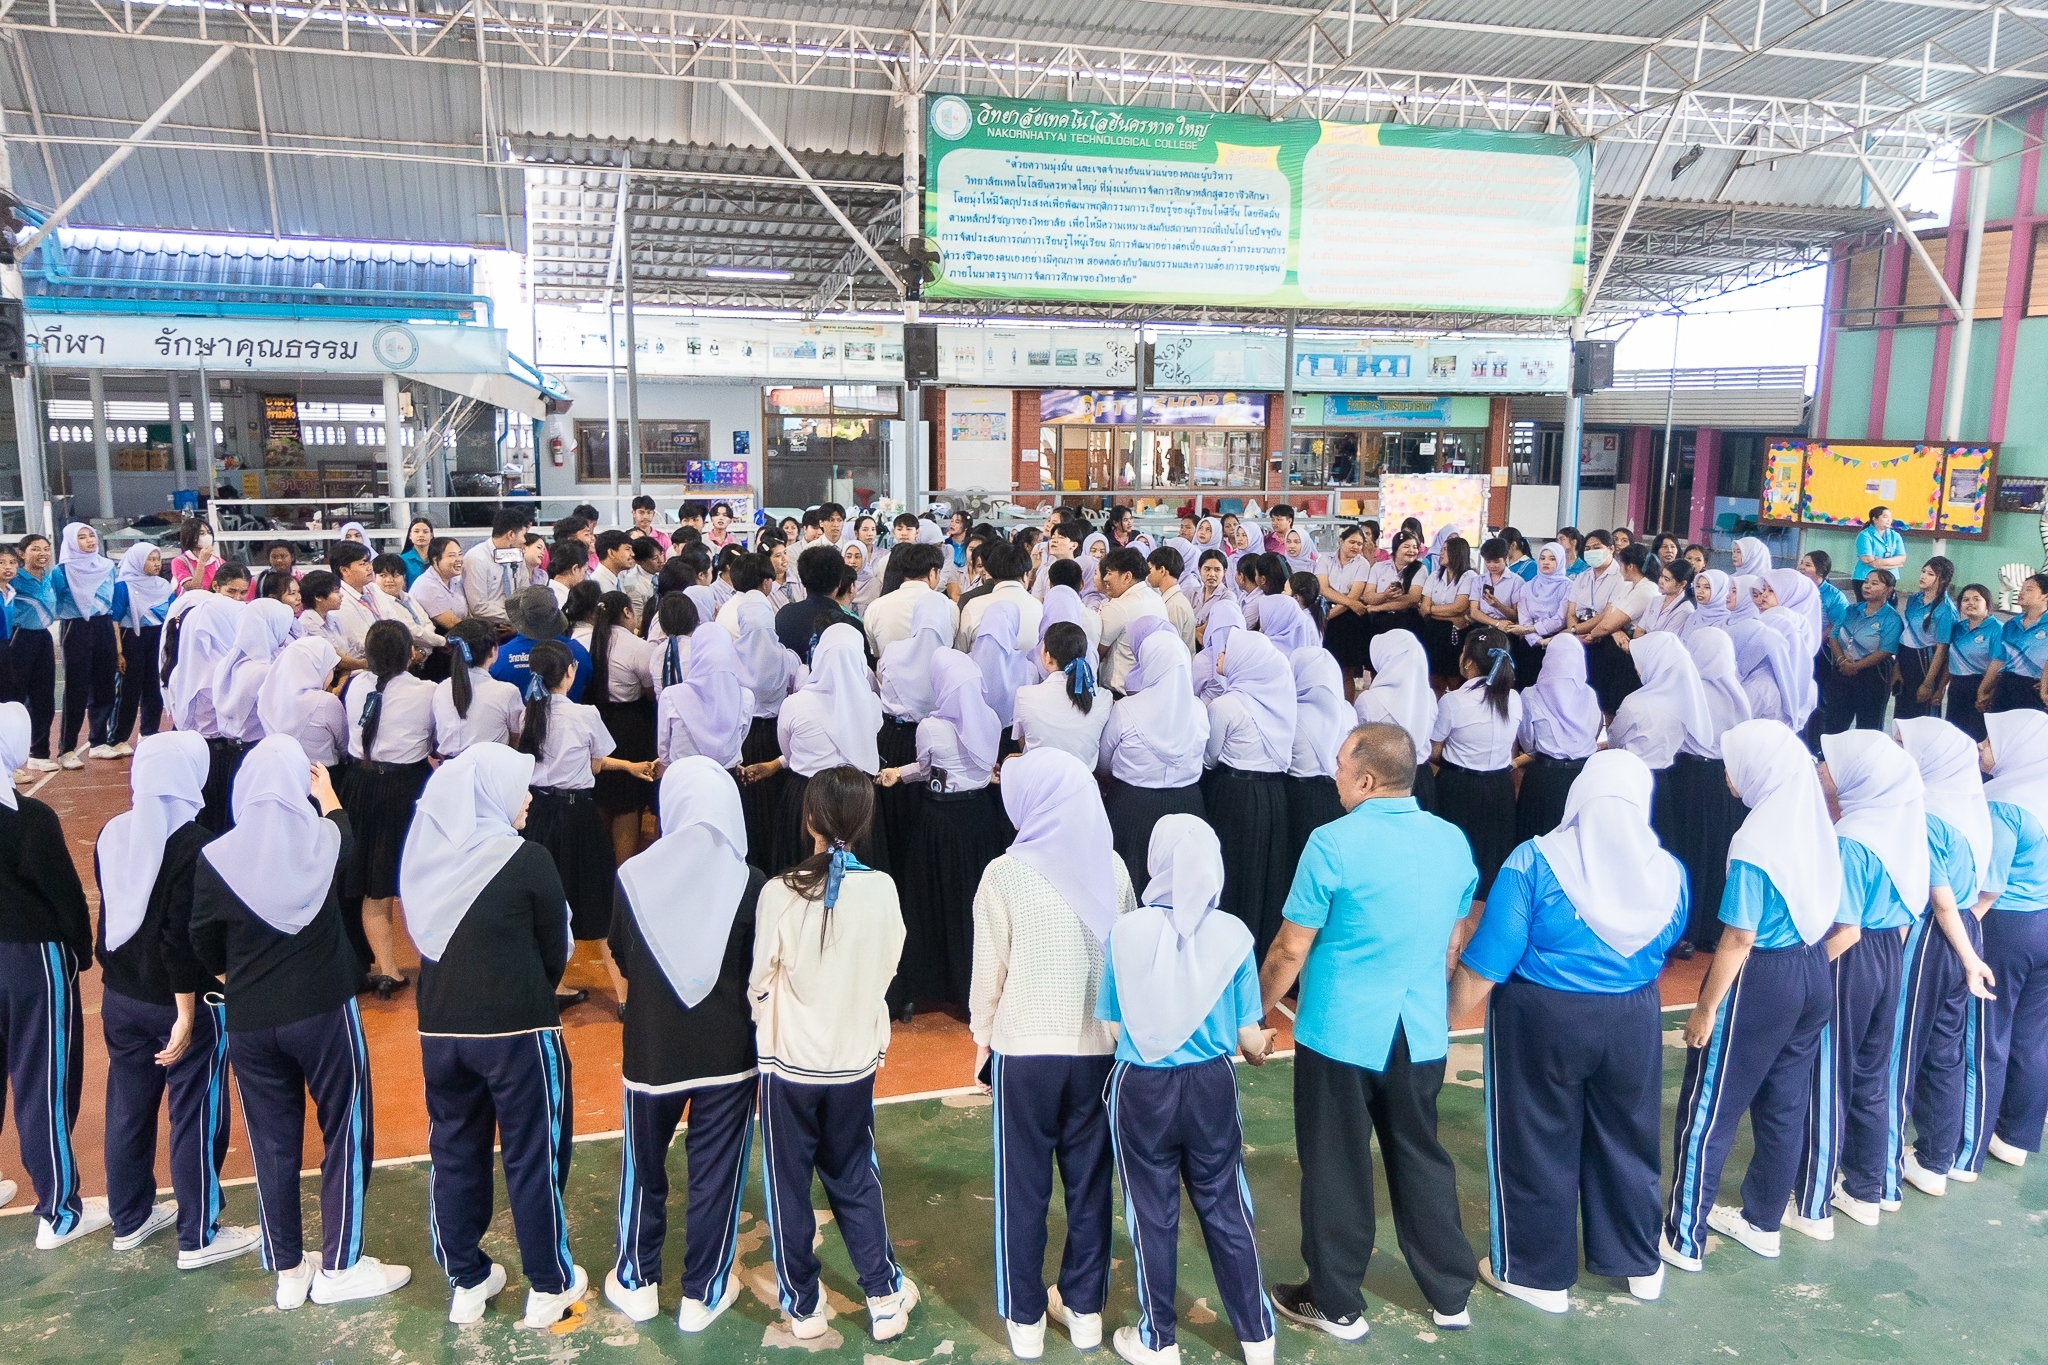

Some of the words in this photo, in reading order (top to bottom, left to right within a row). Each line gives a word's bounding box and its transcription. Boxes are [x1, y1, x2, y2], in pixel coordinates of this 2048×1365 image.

[976, 102, 1214, 142] วิทยาลัยเทคโนโลยีนครหาดใหญ่
[987, 127, 1067, 142] NAKORNHATYAI
[1070, 133, 1151, 148] TECHNOLOGICAL
[1154, 139, 1198, 150] COLLEGE
[154, 327, 358, 367] รักษาคุณธรรม
[795, 392, 823, 403] SHOP
[1152, 394, 1219, 414] SHOP
[673, 435, 697, 443] OPEN
[1605, 438, 1614, 449] 2
